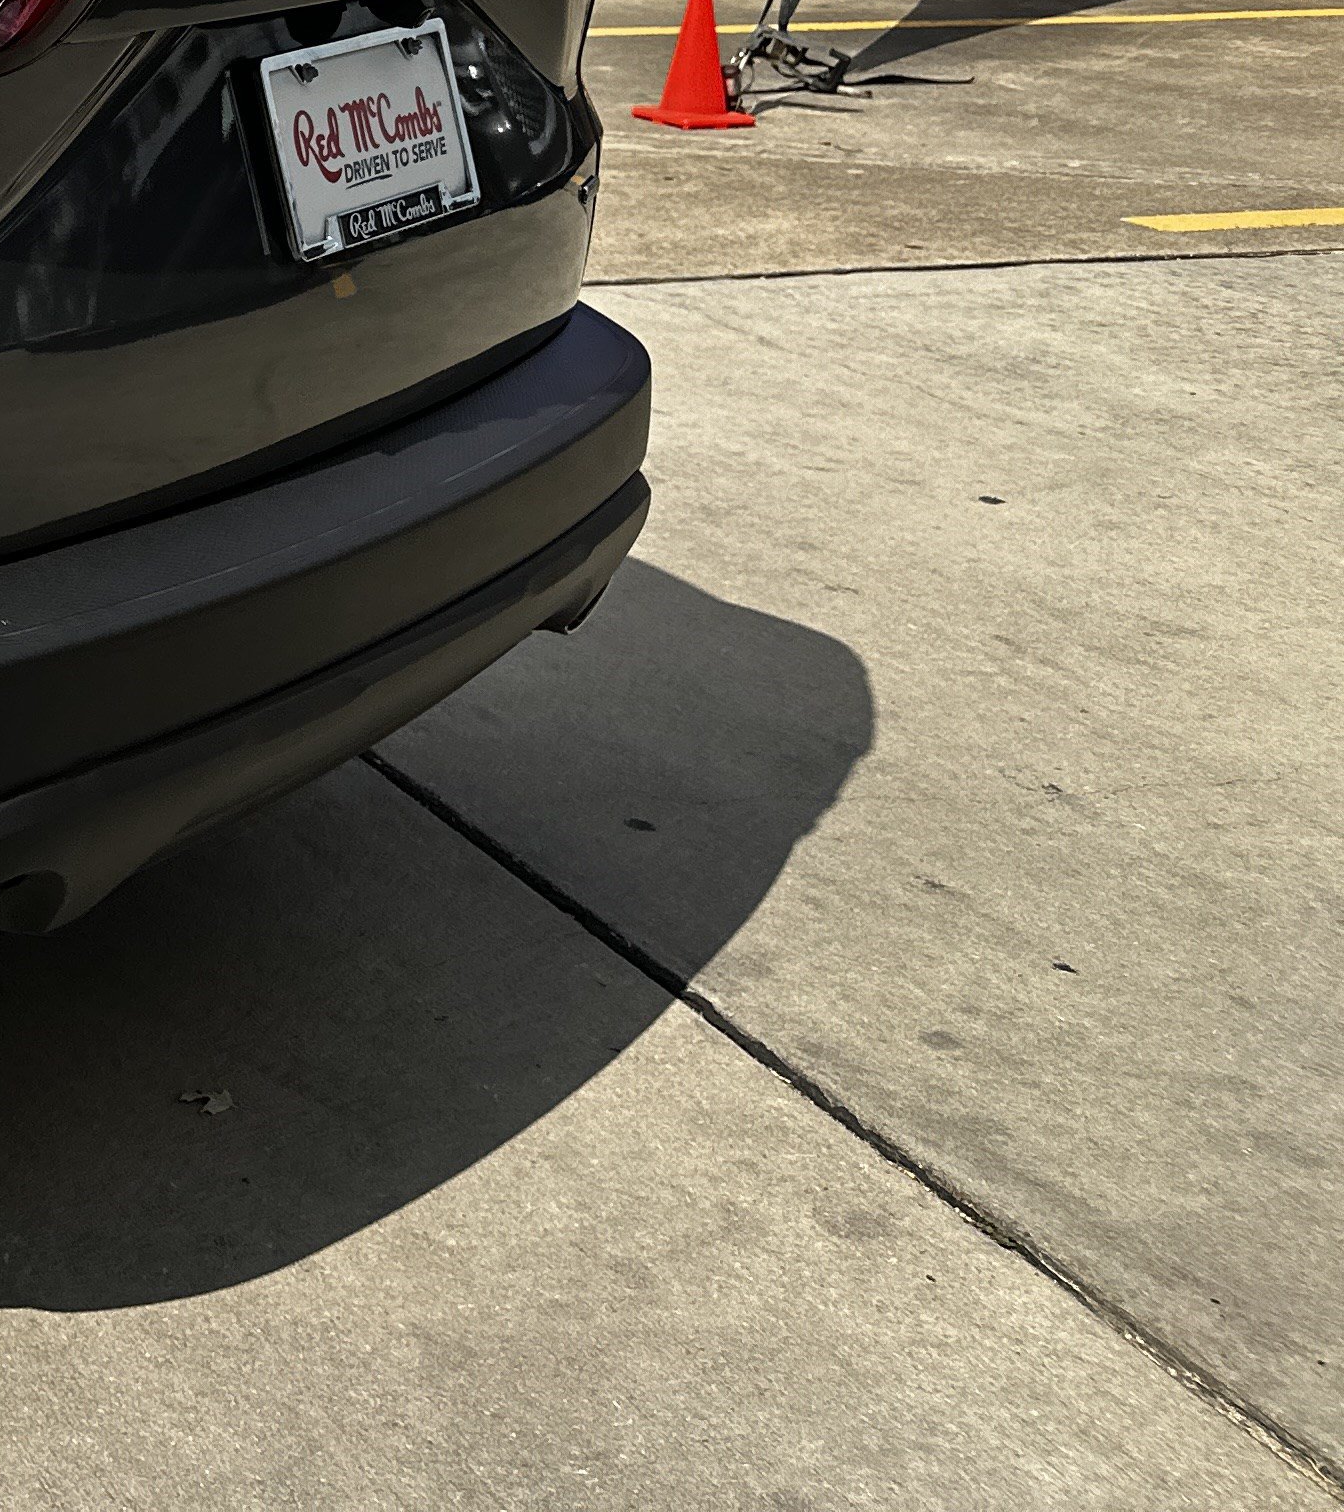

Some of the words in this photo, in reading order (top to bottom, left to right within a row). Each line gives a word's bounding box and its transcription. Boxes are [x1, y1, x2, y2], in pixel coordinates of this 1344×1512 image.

[293, 107, 346, 184] Red
[338, 86, 443, 154] McCombs
[344, 153, 391, 184] DRIVEN
[391, 147, 410, 169] TO
[412, 135, 448, 164] SERVE
[349, 212, 378, 240] Red
